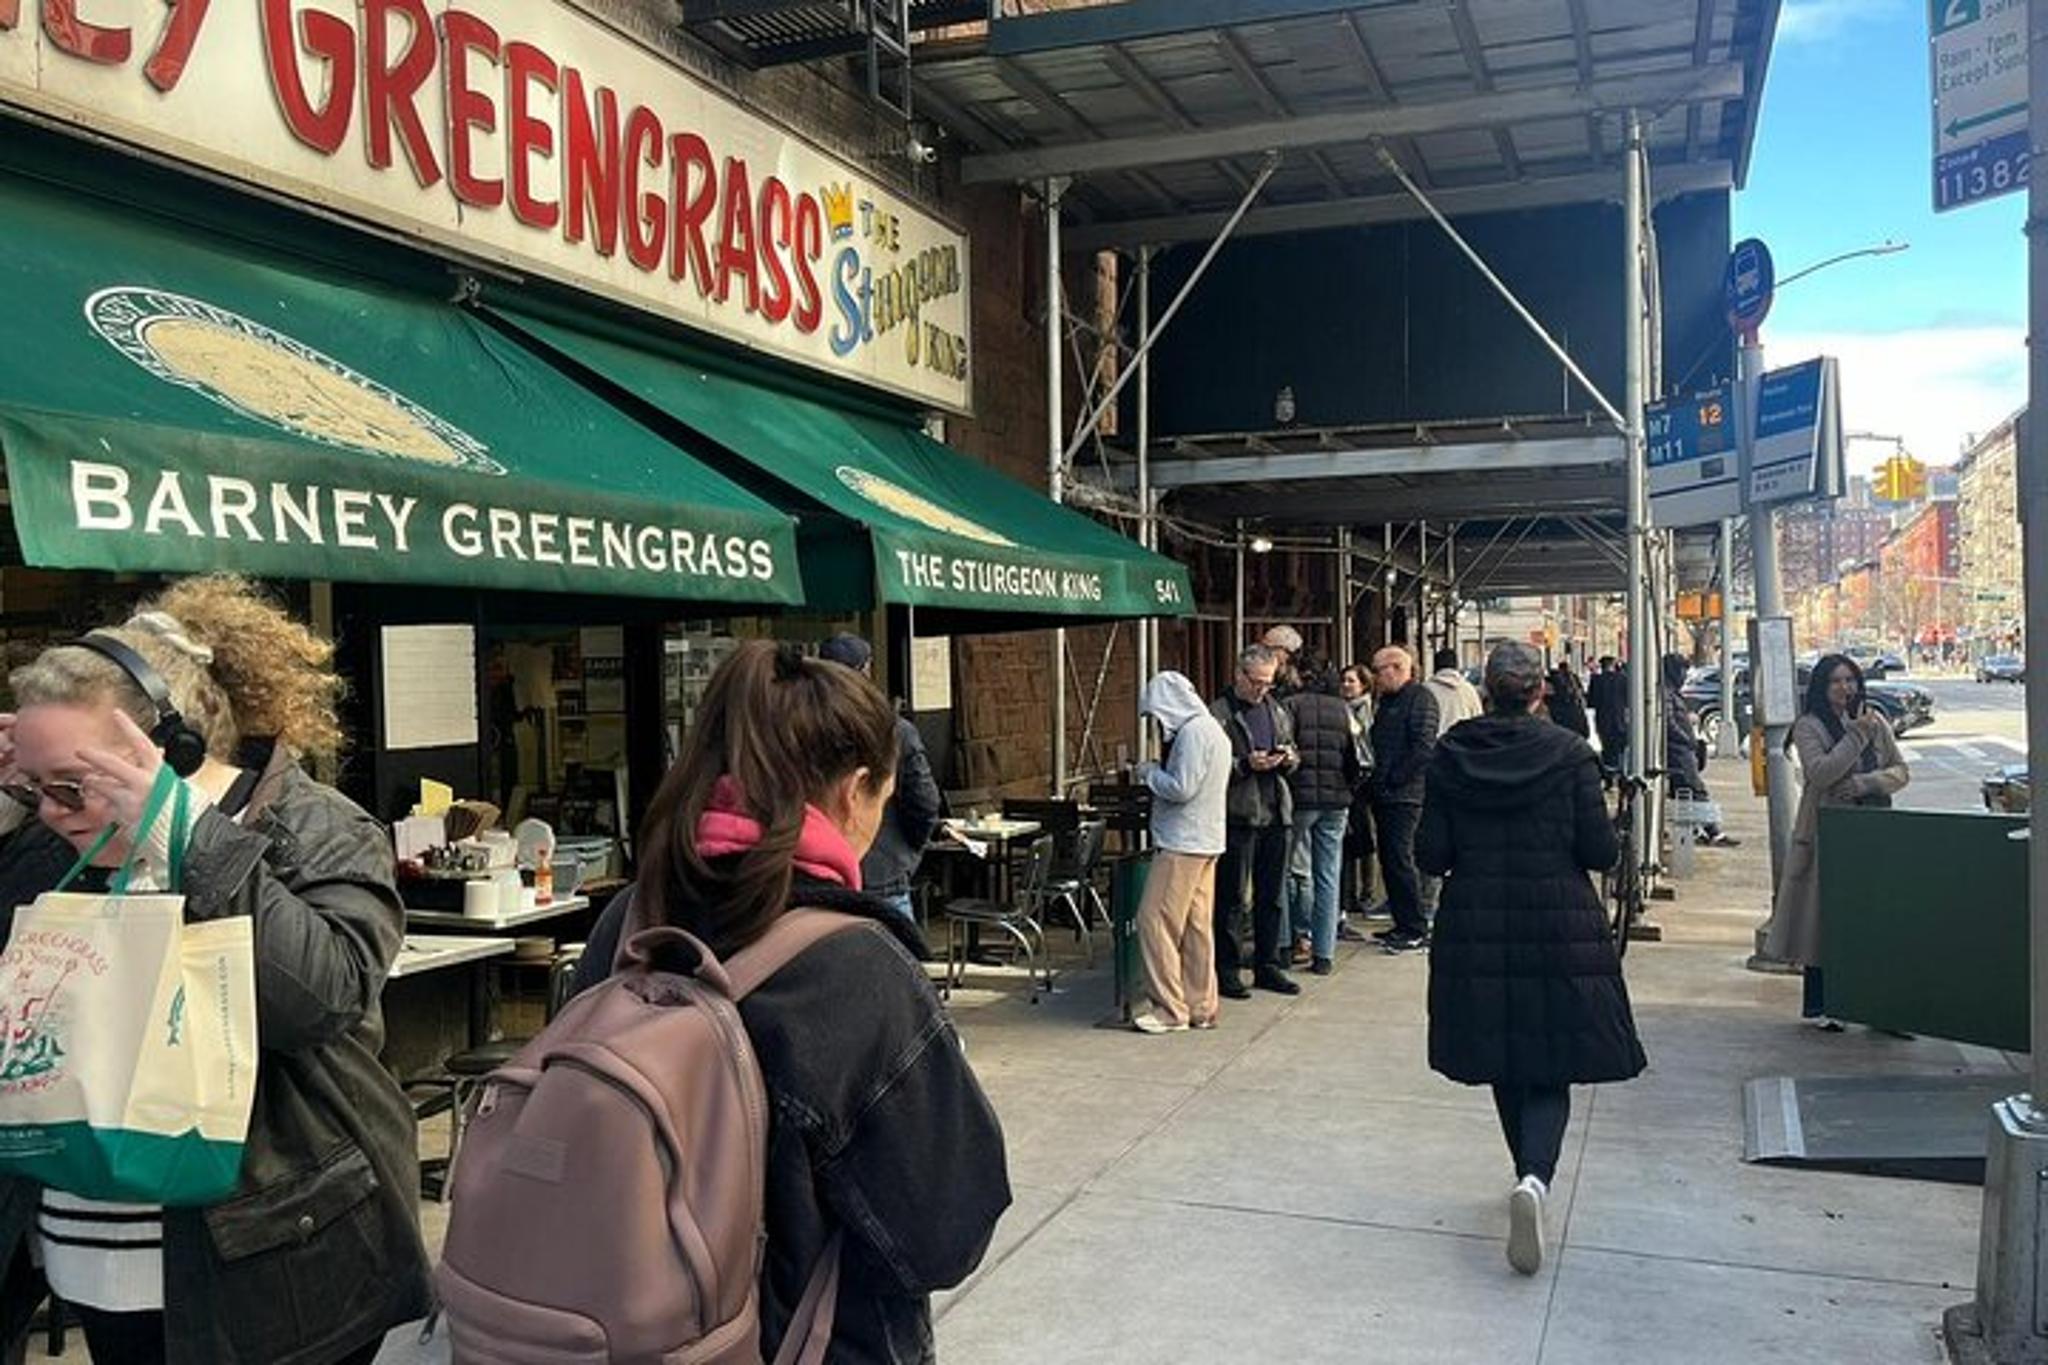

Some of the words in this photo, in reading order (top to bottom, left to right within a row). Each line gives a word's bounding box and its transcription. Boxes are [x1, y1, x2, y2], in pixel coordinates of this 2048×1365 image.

[260, 0, 822, 334] GREENGRASS
[859, 200, 899, 252] THE
[70, 460, 417, 554] BARNEY
[442, 503, 774, 581] GREENGRASS
[896, 549, 946, 590] THE
[952, 559, 1058, 599] STURGEON
[1062, 570, 1102, 601] KING
